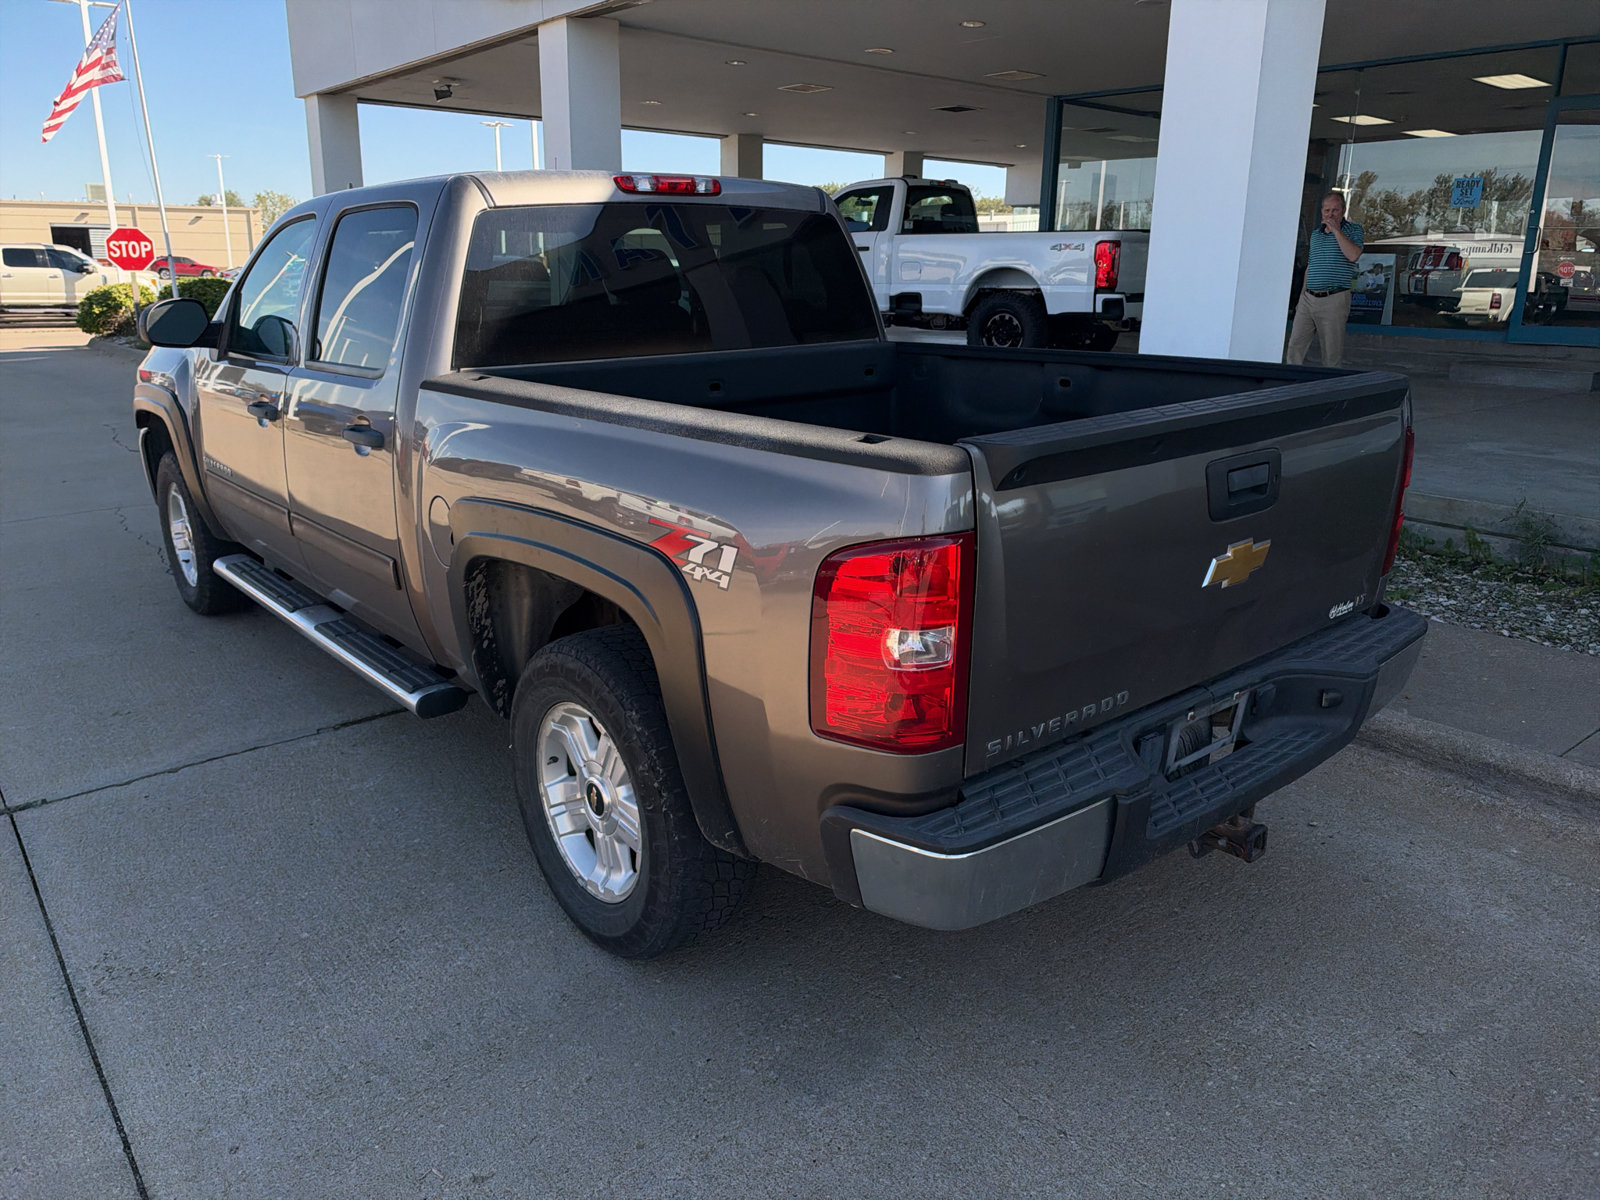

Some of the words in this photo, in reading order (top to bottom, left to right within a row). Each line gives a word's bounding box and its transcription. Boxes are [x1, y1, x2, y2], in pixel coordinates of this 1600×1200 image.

[1456, 180, 1480, 188] READY
[109, 241, 151, 258] STOP
[985, 690, 1130, 759] SILVERADO
